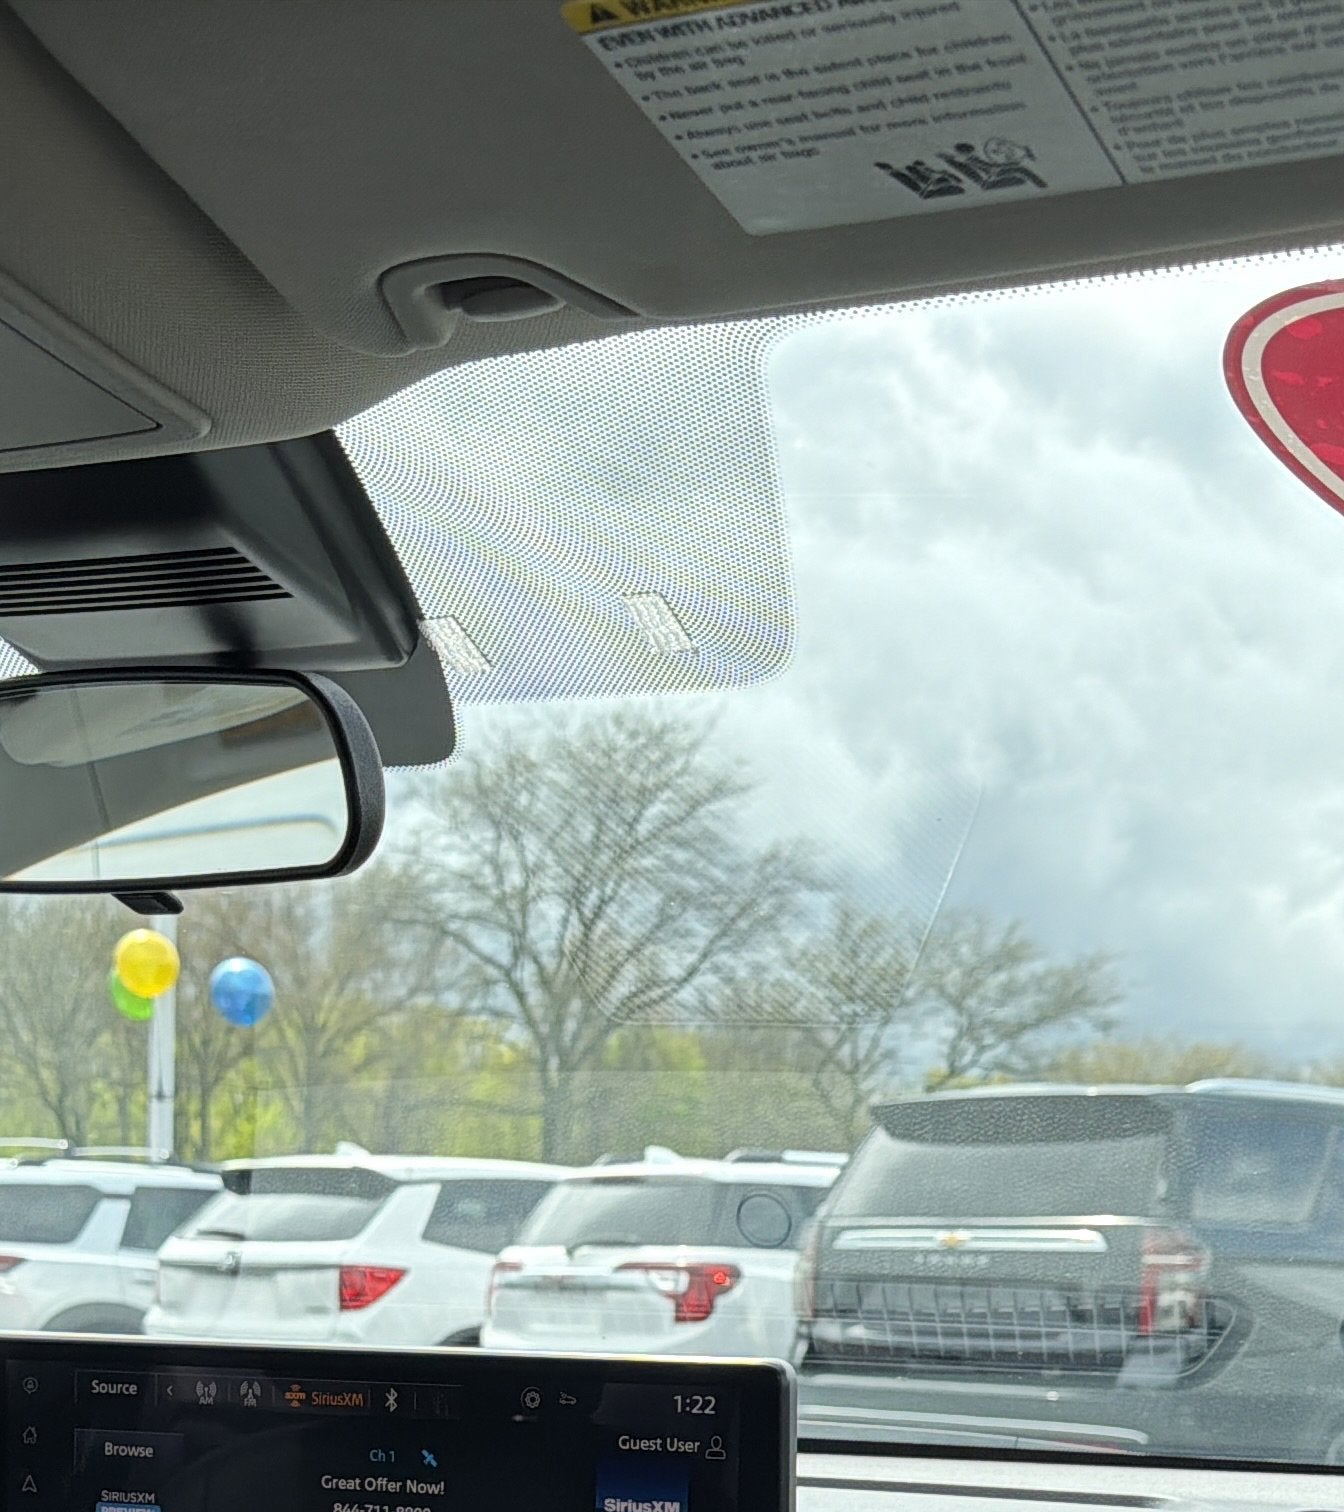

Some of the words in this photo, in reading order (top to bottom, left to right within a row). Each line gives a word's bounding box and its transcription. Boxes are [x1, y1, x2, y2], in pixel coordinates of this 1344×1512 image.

[91, 1379, 138, 1396] Source
[311, 1391, 364, 1408] SiriusXM
[673, 1395, 716, 1414] 1:22
[104, 1442, 154, 1458] Browse
[618, 1435, 663, 1452] Guest
[666, 1437, 700, 1453] User
[369, 1449, 386, 1463] Ch
[389, 1450, 396, 1463] 1
[321, 1475, 361, 1491] Great
[364, 1477, 402, 1493] Offer
[406, 1479, 445, 1495] Now!
